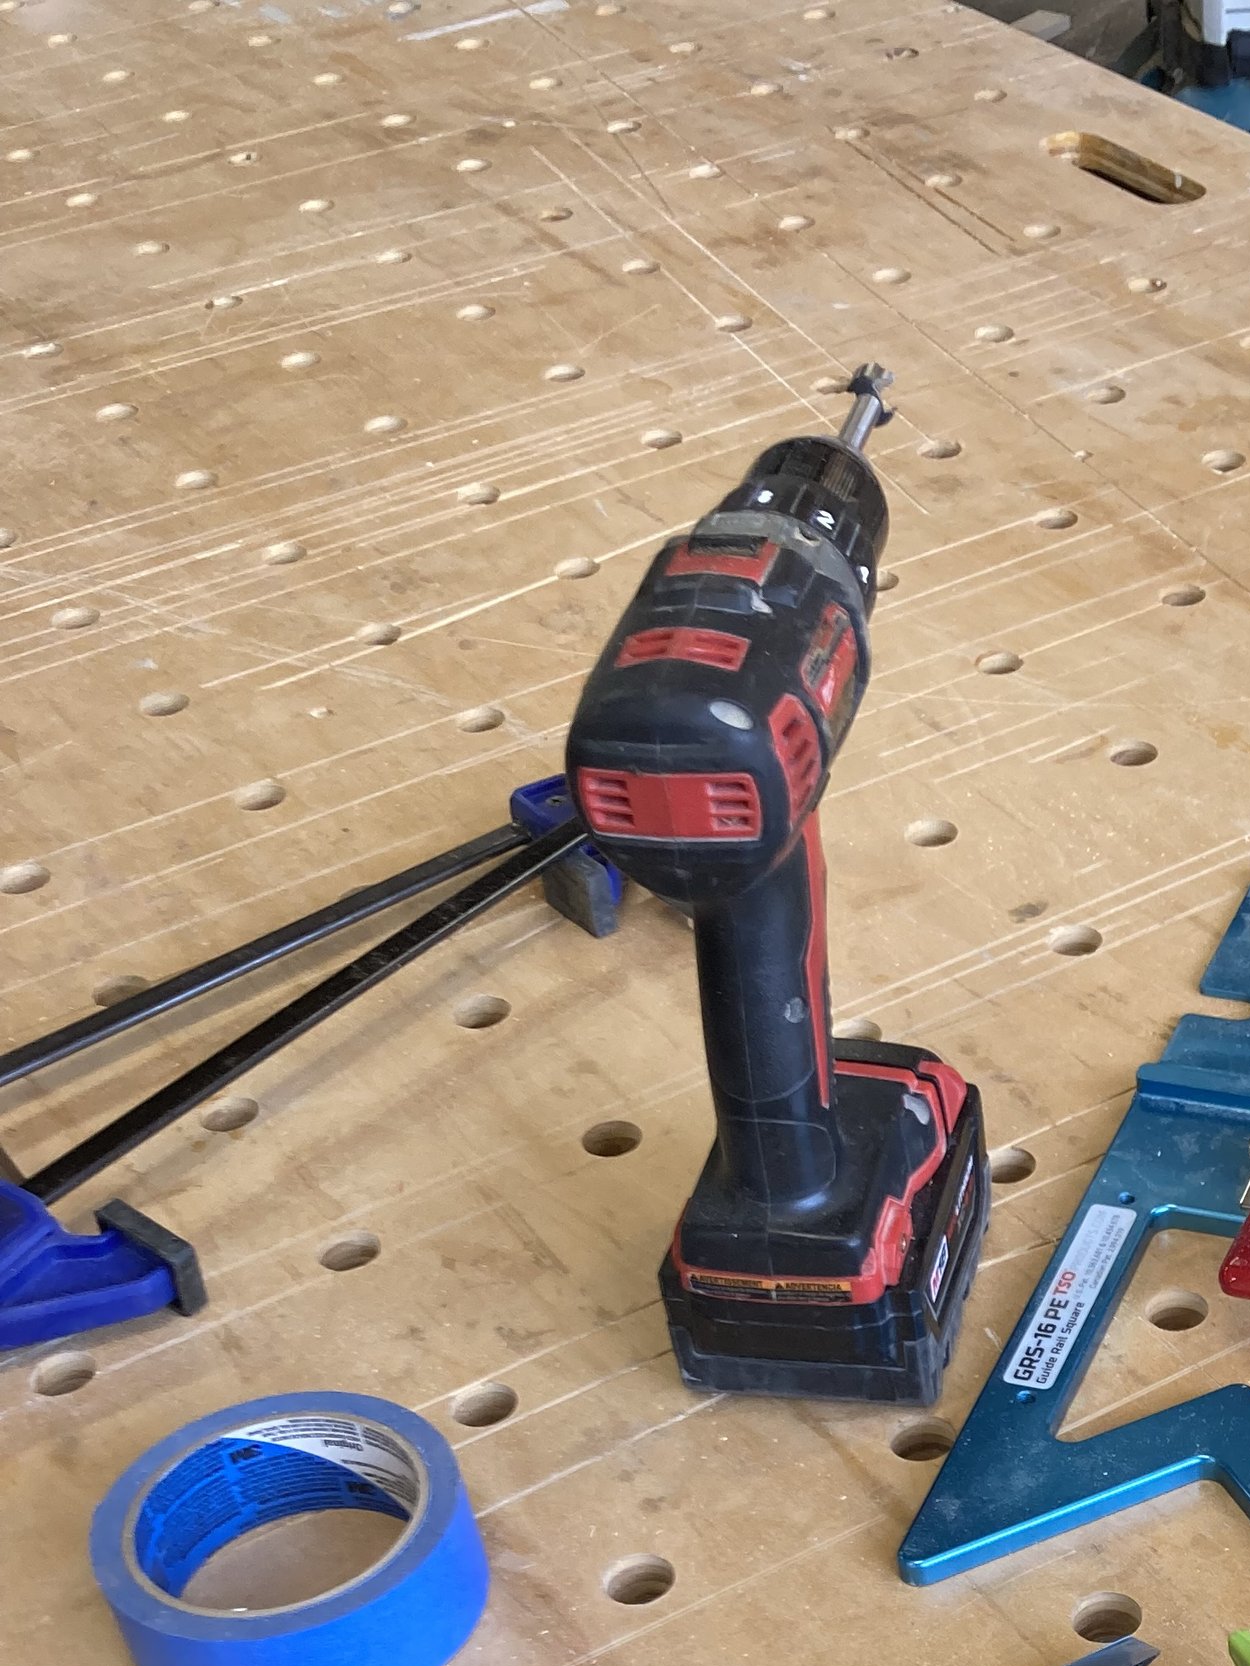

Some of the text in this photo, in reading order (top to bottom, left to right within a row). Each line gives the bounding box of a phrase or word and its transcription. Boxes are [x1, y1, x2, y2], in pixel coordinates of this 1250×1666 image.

[1051, 1270, 1077, 1297] TSO
[1012, 1296, 1069, 1381] GRS-16 PE
[1034, 1301, 1086, 1384] Guide Rail Square
